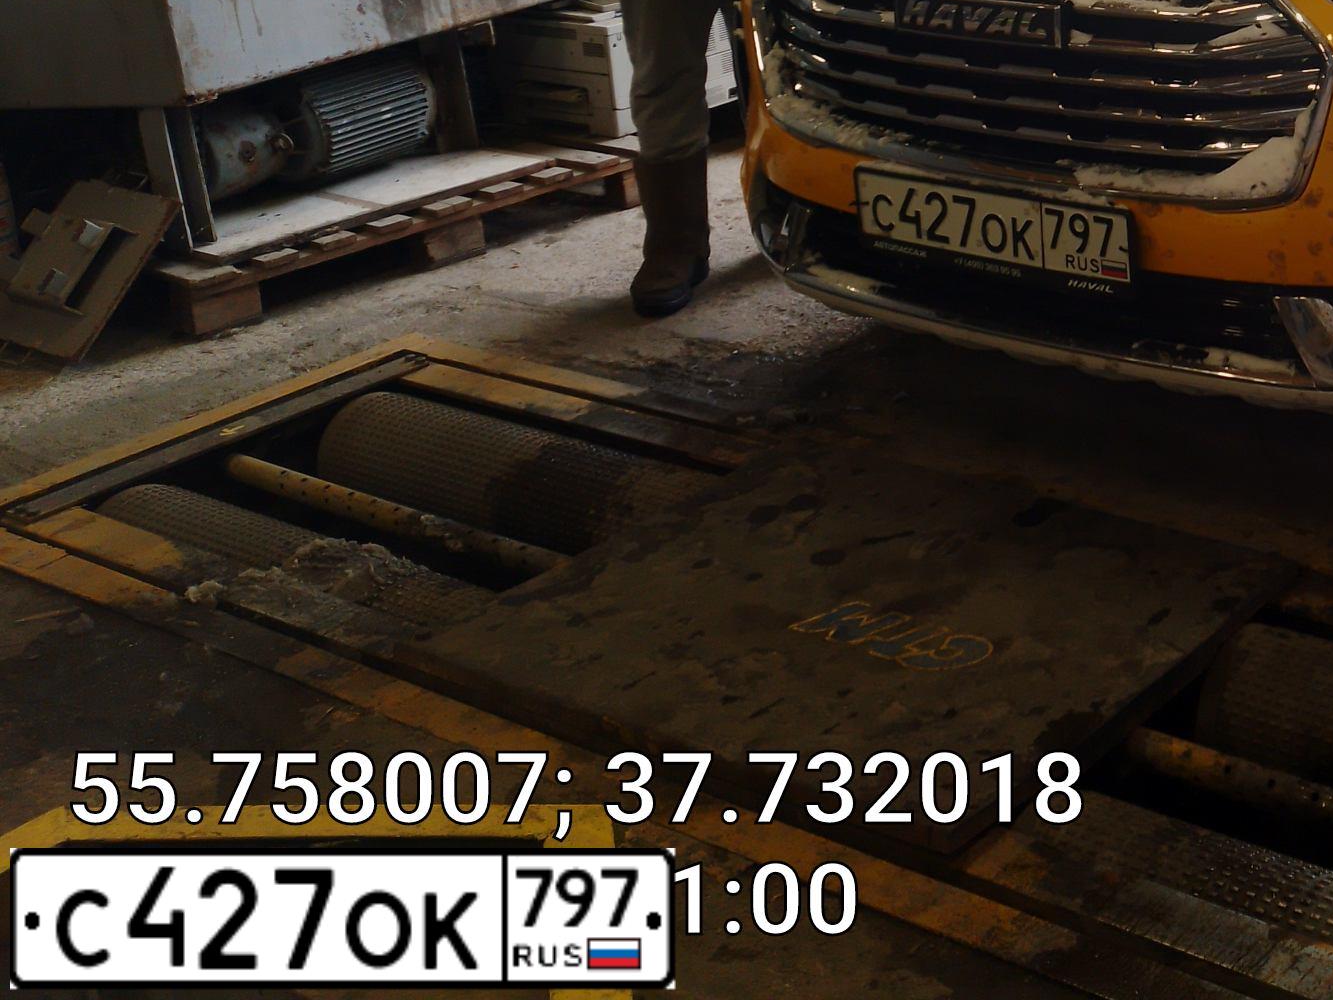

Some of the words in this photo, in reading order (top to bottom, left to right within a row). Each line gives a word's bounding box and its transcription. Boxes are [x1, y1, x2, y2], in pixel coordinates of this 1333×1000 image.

[901, 0, 1047, 41] HAVAL
[1044, 207, 1114, 258] 797
[1065, 254, 1100, 273] RUS
[1067, 279, 1114, 294] HAVAL
